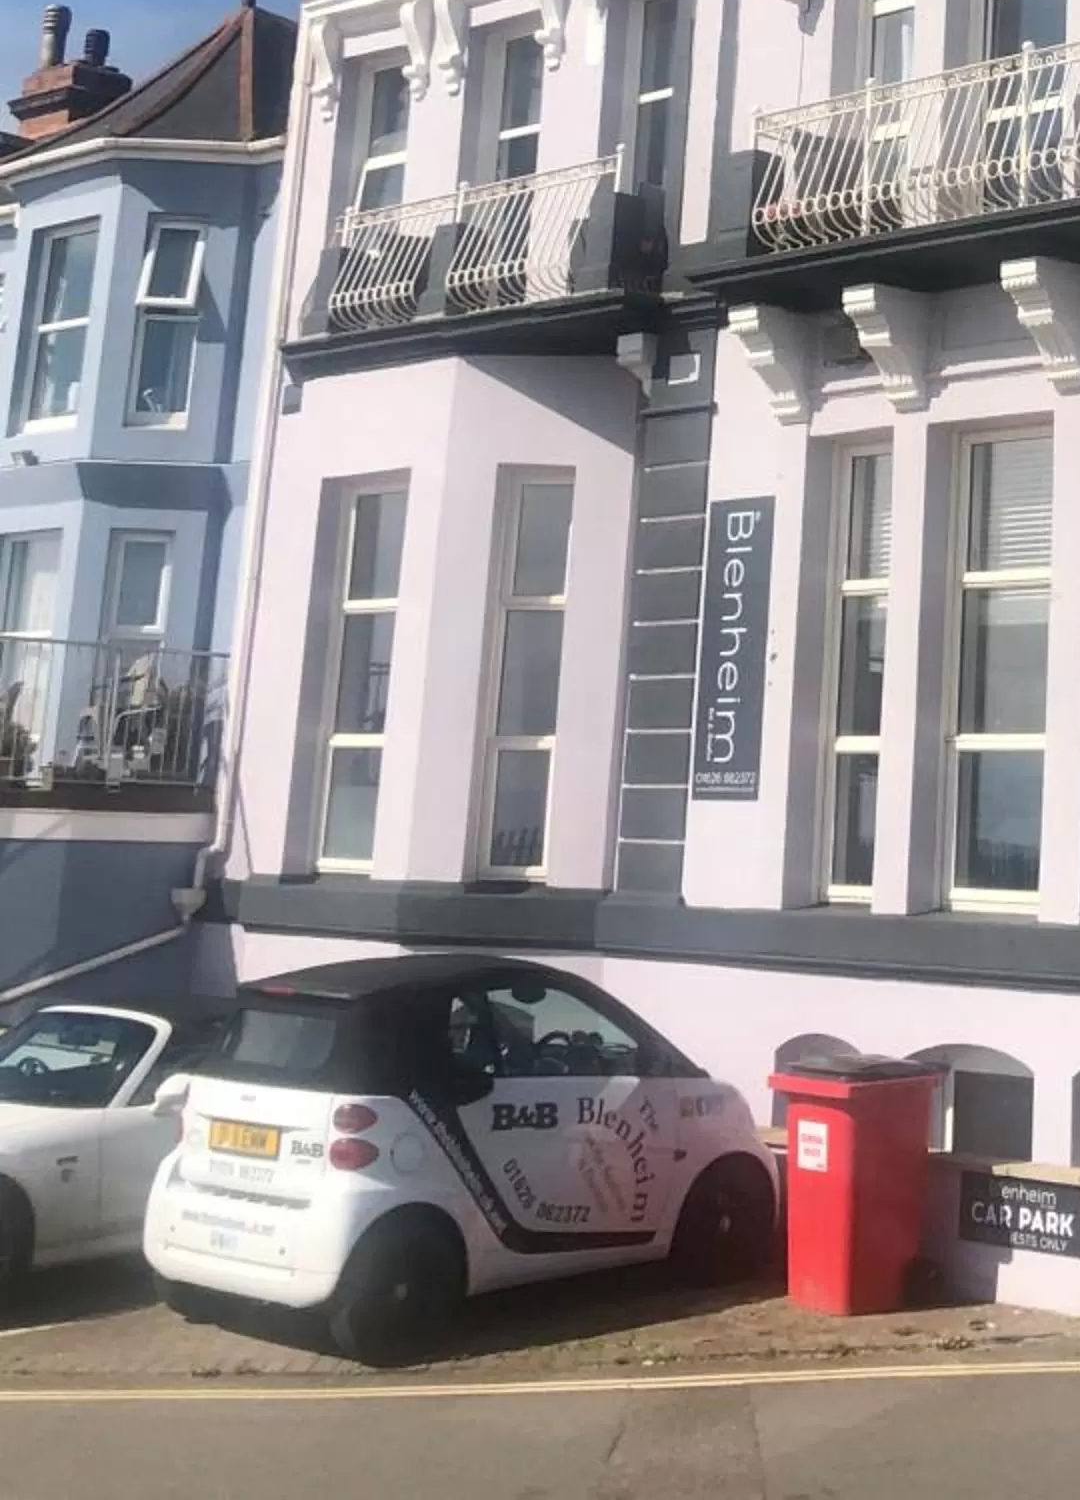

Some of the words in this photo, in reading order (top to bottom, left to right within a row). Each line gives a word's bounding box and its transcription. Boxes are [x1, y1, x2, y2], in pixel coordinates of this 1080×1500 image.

[713, 510, 754, 763] Blenheim
[492, 1103, 559, 1131] B&B
[290, 1139, 325, 1158] B&B
[576, 1096, 656, 1223] Blenheim
[994, 1182, 1057, 1206] enheim
[971, 1201, 1013, 1228] CAR
[1019, 1207, 1075, 1237] PARK
[1039, 1237, 1068, 1252] ONLY
